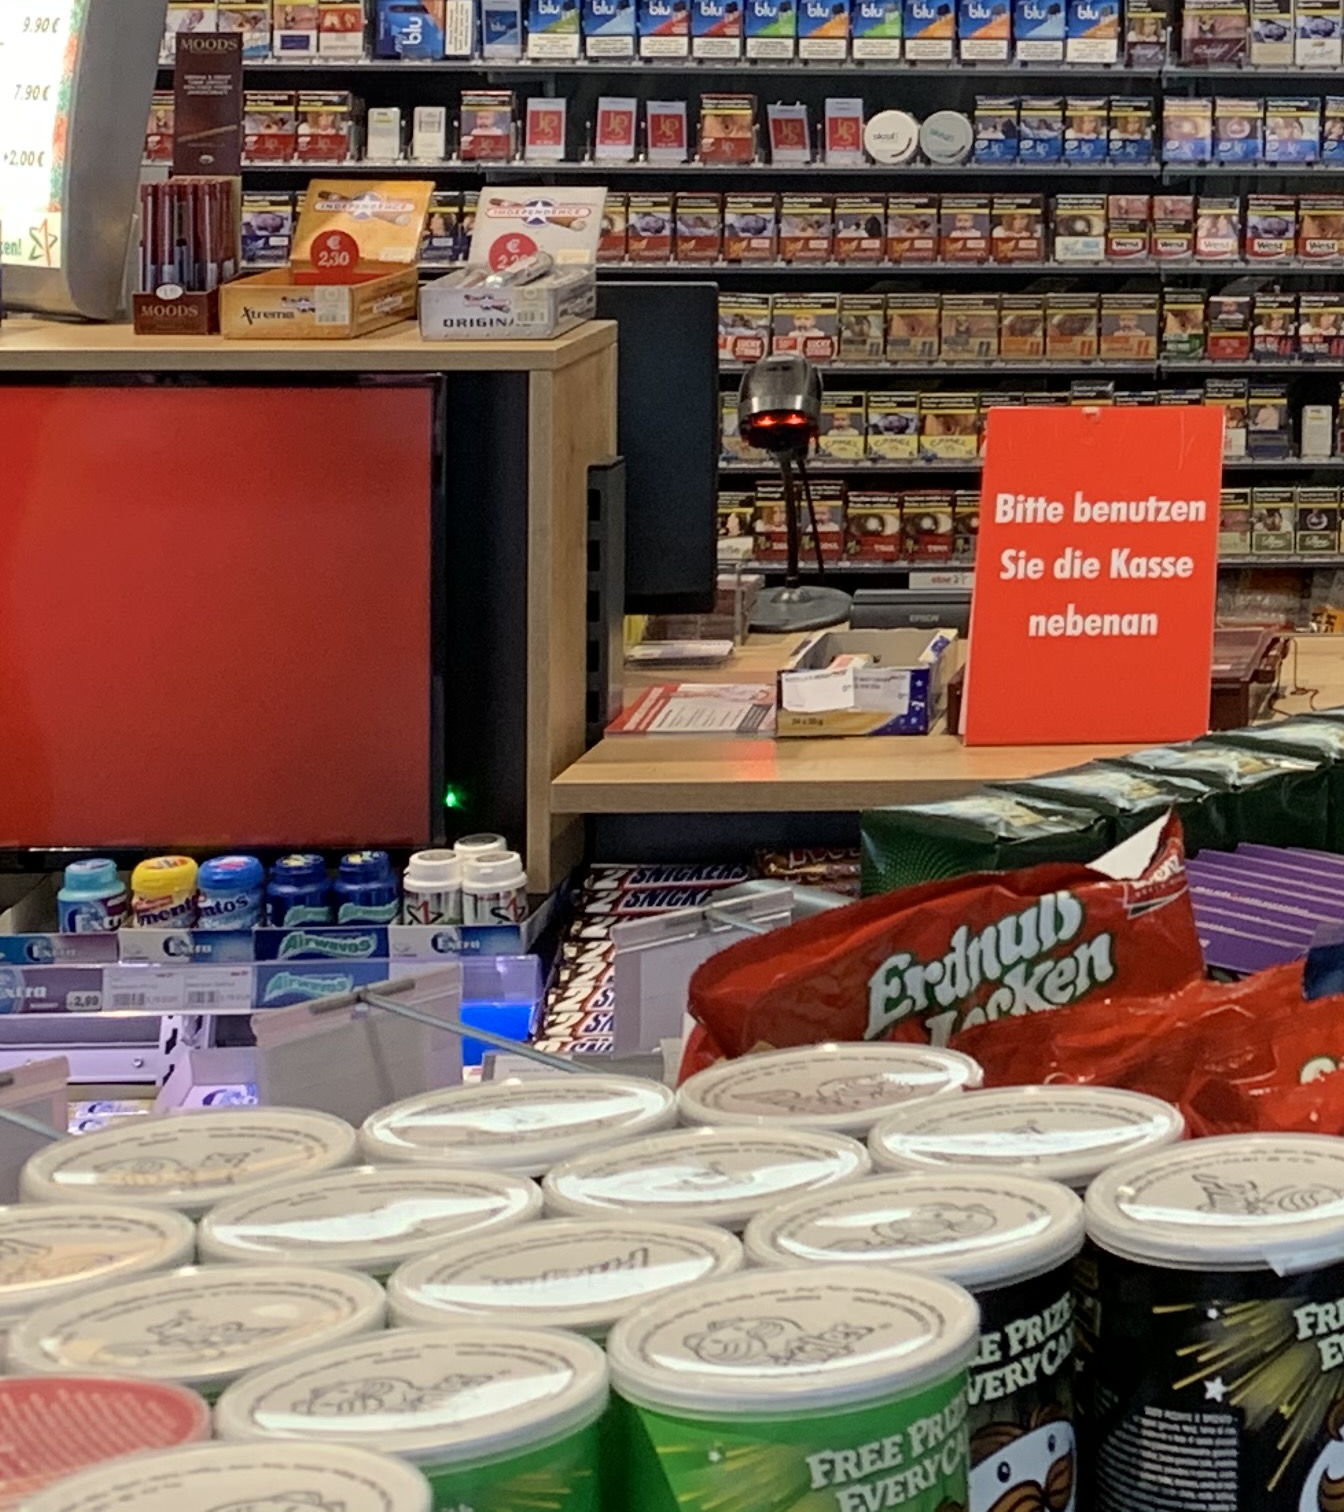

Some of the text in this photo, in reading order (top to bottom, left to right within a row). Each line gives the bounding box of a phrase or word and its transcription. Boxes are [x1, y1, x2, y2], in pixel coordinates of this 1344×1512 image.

[538, 0, 560, 15] blu
[592, 0, 614, 15] blu
[649, 0, 671, 15] blu
[700, 1, 722, 16] blu
[754, 2, 777, 17] blu
[807, 2, 829, 18] blu
[861, 2, 883, 18] blu
[912, 2, 935, 19] blu
[23, 18, 60, 34] 9.90 €
[402, 16, 423, 46] blu
[180, 38, 238, 52] MOODS
[14, 85, 51, 101] 7.90 €
[36, 150, 46, 167] €
[327, 235, 341, 249] €
[507, 238, 520, 253] €
[318, 251, 352, 269] 2,30
[141, 304, 199, 318] MOODS
[995, 491, 1207, 524] Bitte benutzen
[1000, 547, 1195, 580] Sie die Kasse
[1028, 603, 1158, 637] nebenan
[1005, 1291, 1075, 1356] PRIZE
[805, 1428, 902, 1491] FREE
